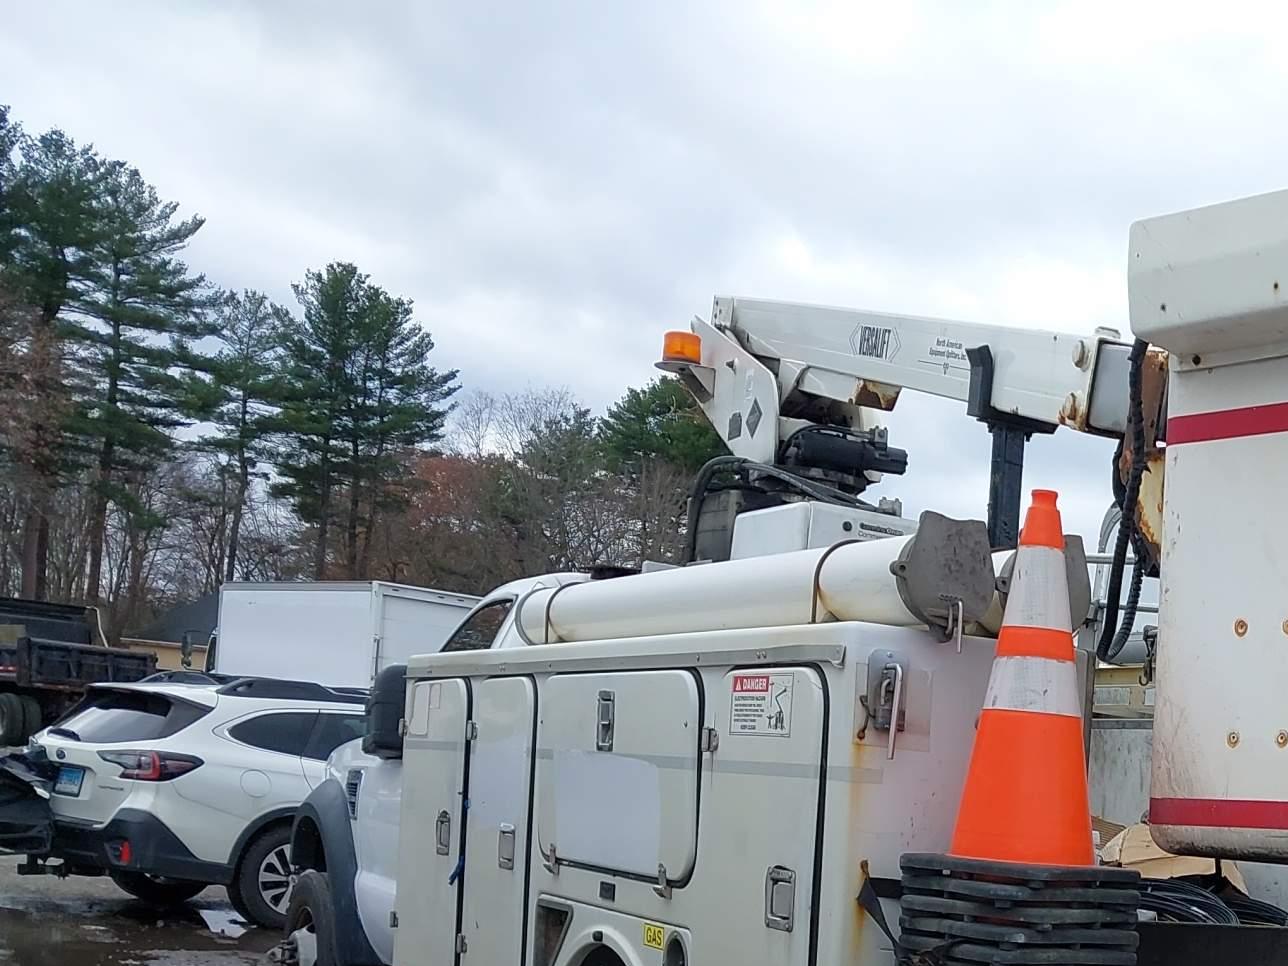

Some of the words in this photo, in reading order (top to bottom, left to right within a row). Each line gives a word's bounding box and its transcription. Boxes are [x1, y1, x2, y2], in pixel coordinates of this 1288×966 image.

[859, 326, 892, 360] VERSALIFT
[742, 678, 767, 691] DANGER
[646, 927, 662, 946] GAS
